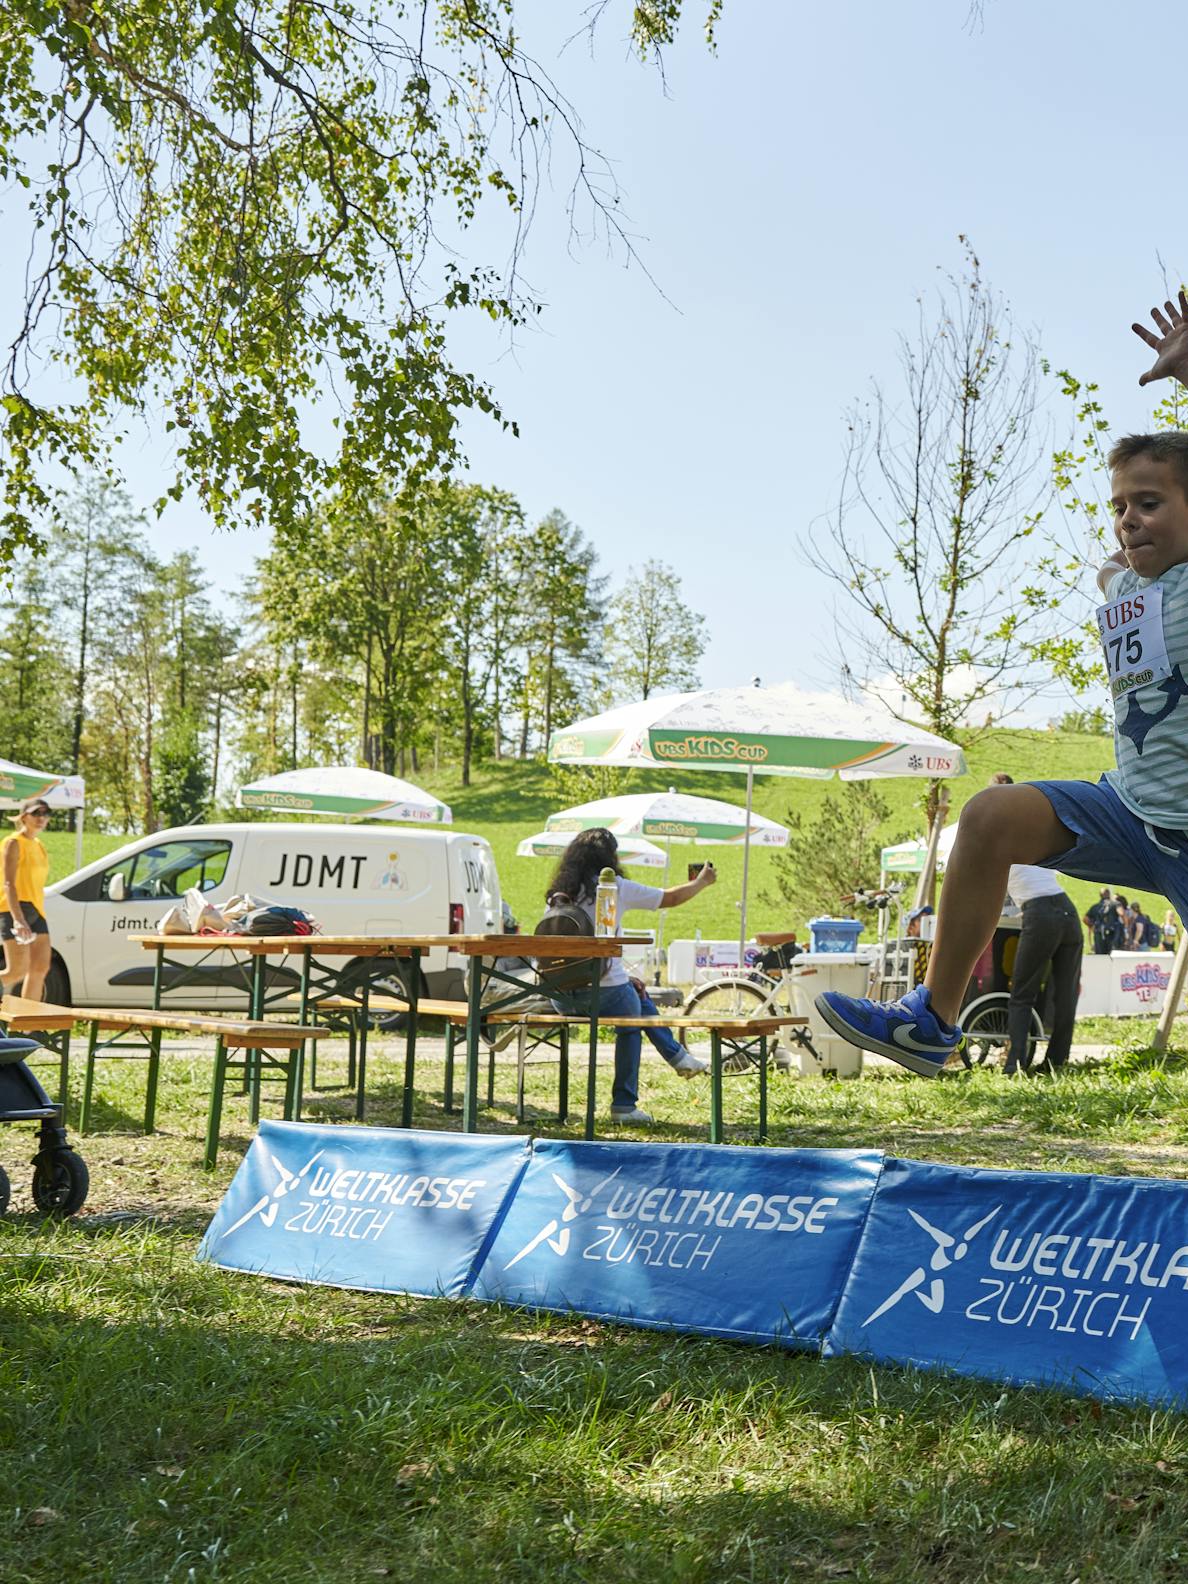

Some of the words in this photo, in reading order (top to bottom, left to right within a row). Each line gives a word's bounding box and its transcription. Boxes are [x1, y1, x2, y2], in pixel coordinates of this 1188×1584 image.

[1104, 595, 1145, 630] UBS
[656, 743, 686, 757] UBS
[686, 737, 736, 757] KIDS
[737, 746, 768, 760] CUP
[927, 757, 952, 770] UBS
[269, 853, 368, 889] JDMT
[309, 1166, 488, 1211] WELTKLASSE
[284, 1199, 395, 1241] ZÜRICH
[606, 1186, 840, 1234] WELTKLASSE
[582, 1222, 723, 1270] ZÜRICH
[965, 1276, 1152, 1340] ZÜRICH
